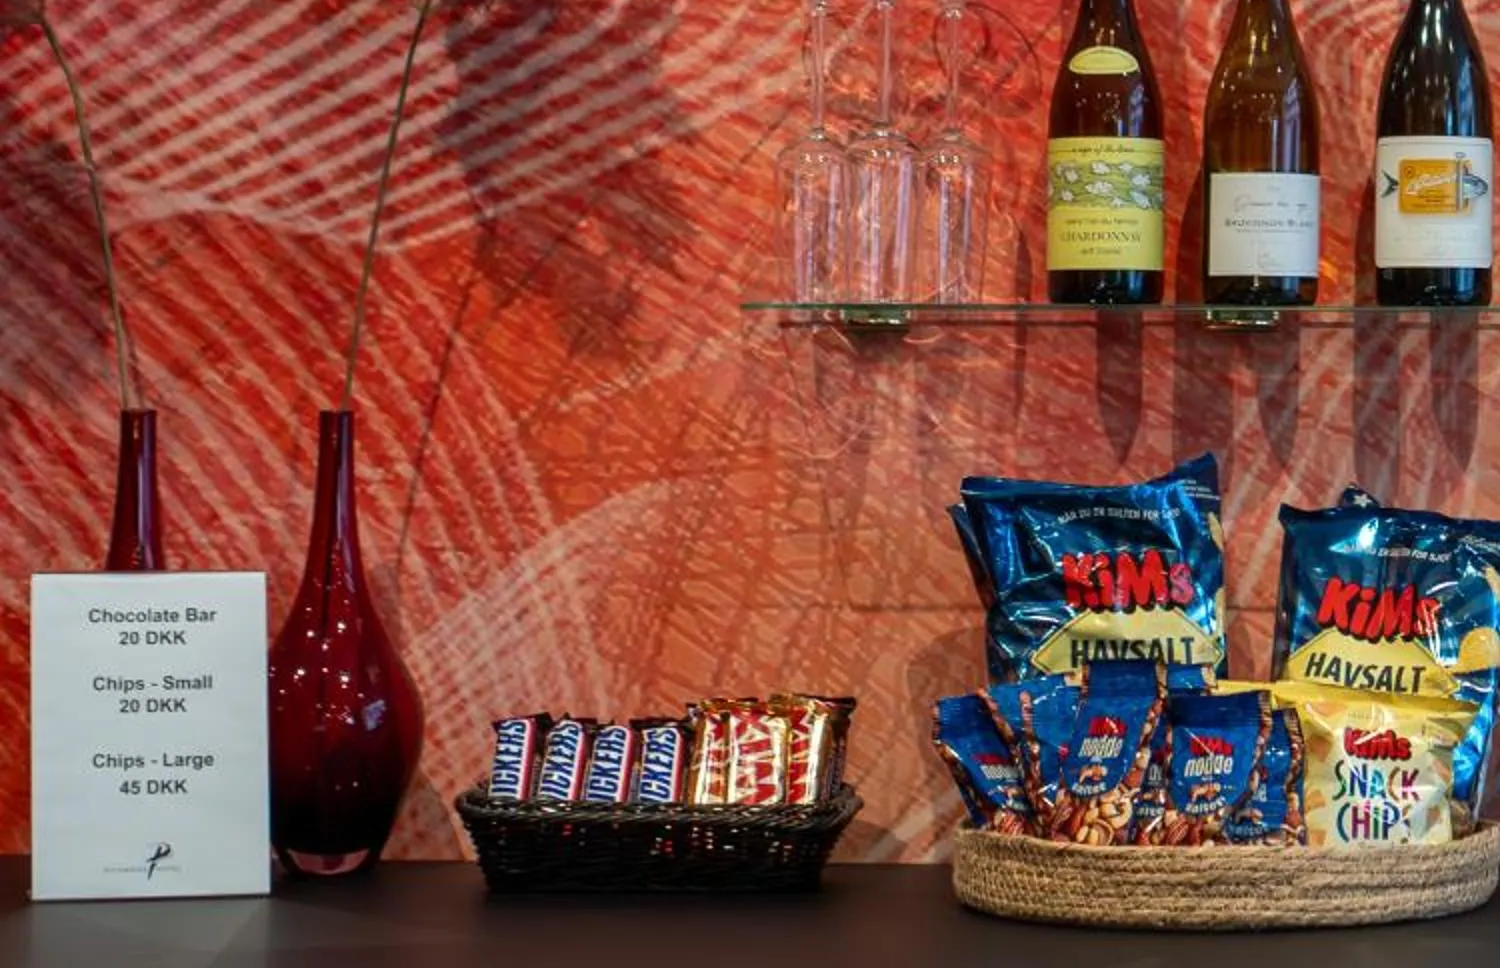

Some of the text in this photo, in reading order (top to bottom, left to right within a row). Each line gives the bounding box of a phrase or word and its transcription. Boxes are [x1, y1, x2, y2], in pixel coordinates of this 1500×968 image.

[88, 608, 217, 624] Chocolate Bar
[118, 631, 187, 646] 20 DKK
[1071, 636, 1195, 670] HAVSALT
[92, 676, 145, 693] Chips
[162, 675, 213, 690] Small
[1305, 651, 1426, 695] HAVSALT
[119, 699, 187, 714] 20 DKK
[92, 753, 145, 771] Chips
[162, 753, 214, 770] Large
[491, 719, 527, 794] ICKERS
[540, 721, 582, 800] ICKERS
[587, 725, 627, 802] ICKERS
[119, 780, 188, 795] 45 DKK
[1332, 759, 1421, 802] SNACK
